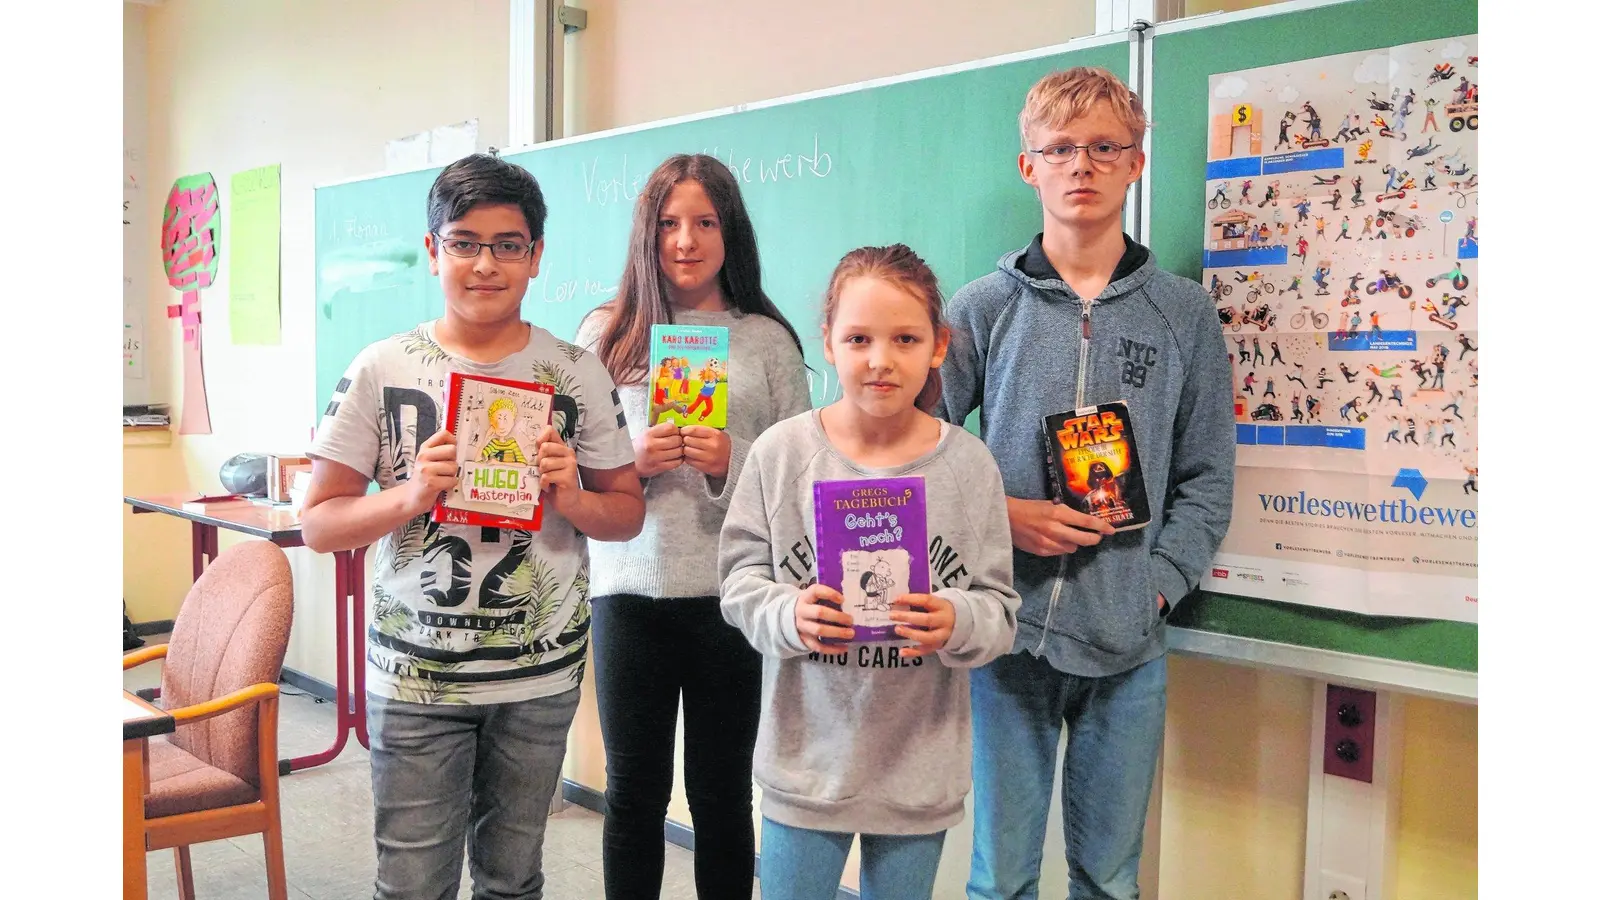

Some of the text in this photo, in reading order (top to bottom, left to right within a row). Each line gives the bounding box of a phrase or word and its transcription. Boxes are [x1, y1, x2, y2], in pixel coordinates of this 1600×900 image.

[662, 335, 718, 345] KARO KAROTTE
[1117, 336, 1157, 367] NYC
[1121, 360, 1147, 389] 89
[1063, 411, 1120, 432] STAR
[1056, 424, 1124, 450] WARS
[470, 488, 533, 504] Masterplan
[833, 488, 912, 510] TAGEBUCH 5
[852, 487, 889, 498] GREGS
[1258, 491, 1478, 529] vorlesewettbewe
[844, 512, 898, 530] Geht's
[859, 526, 904, 548] noch?
[420, 625, 526, 643] DARK TRPICS
